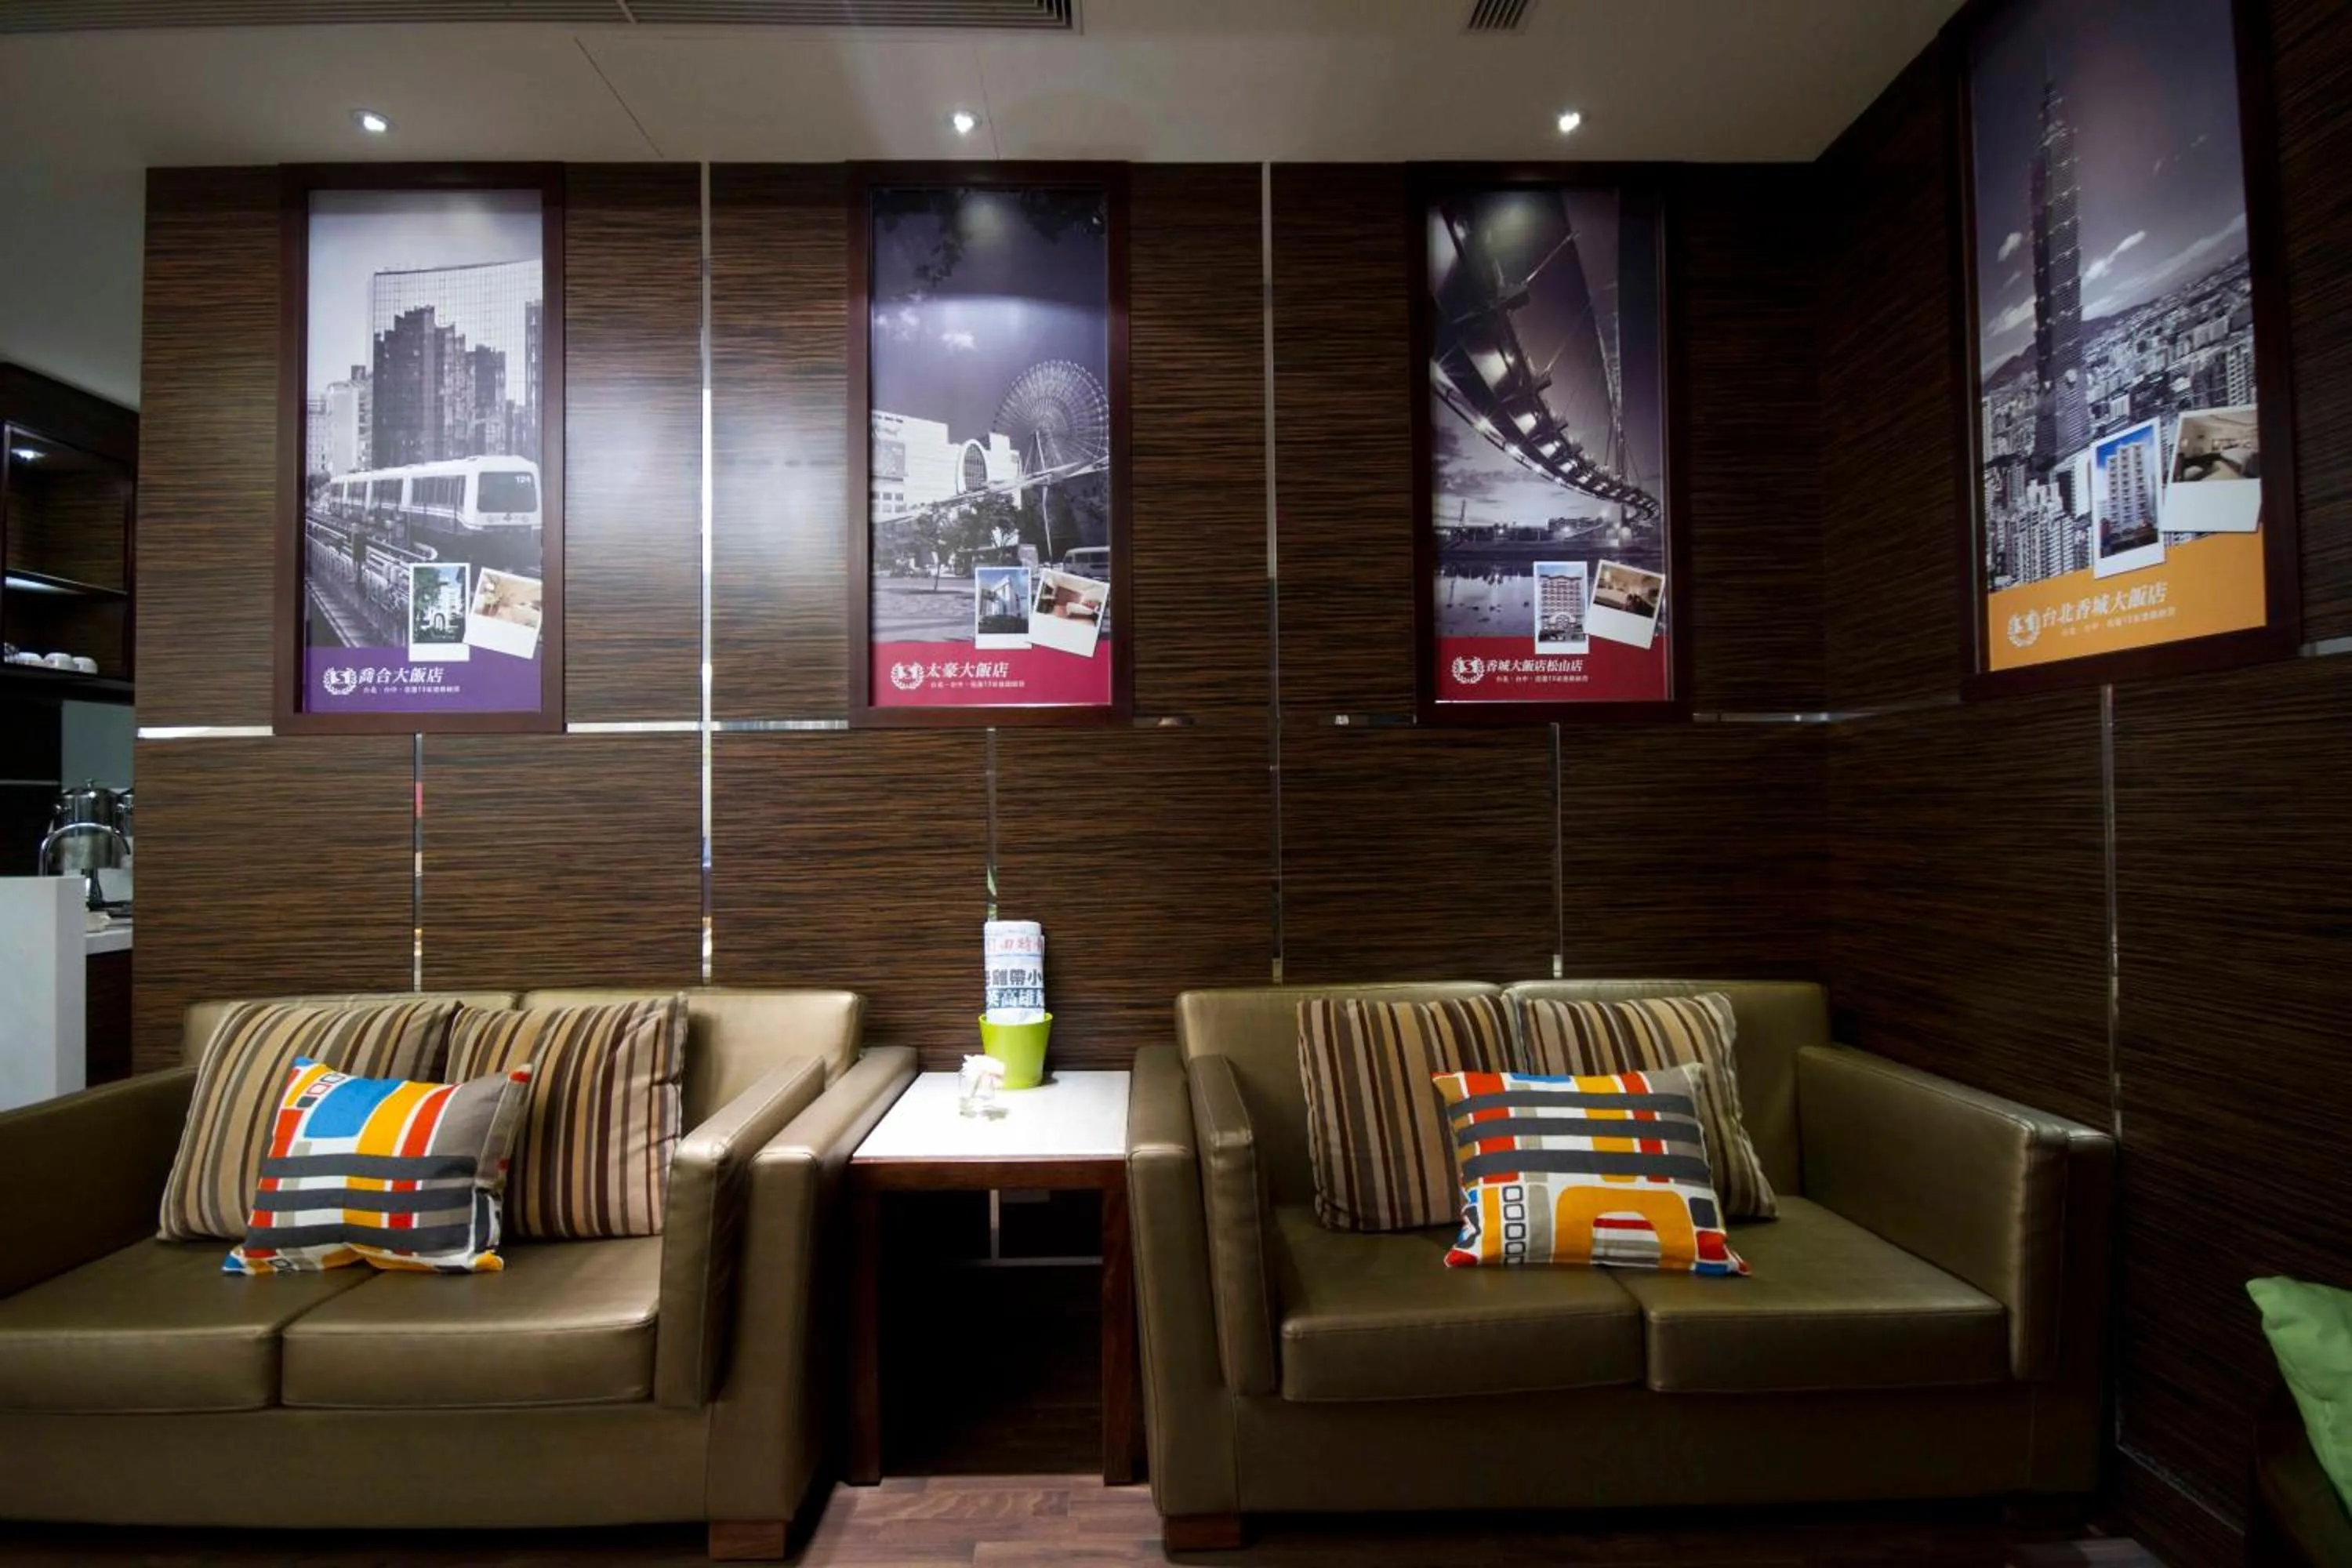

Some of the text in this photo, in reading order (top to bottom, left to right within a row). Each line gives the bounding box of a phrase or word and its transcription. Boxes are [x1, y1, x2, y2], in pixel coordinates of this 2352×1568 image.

[2042, 582, 2168, 628] 台北香城大飯店
[925, 662, 1010, 679] 太豪大飯店
